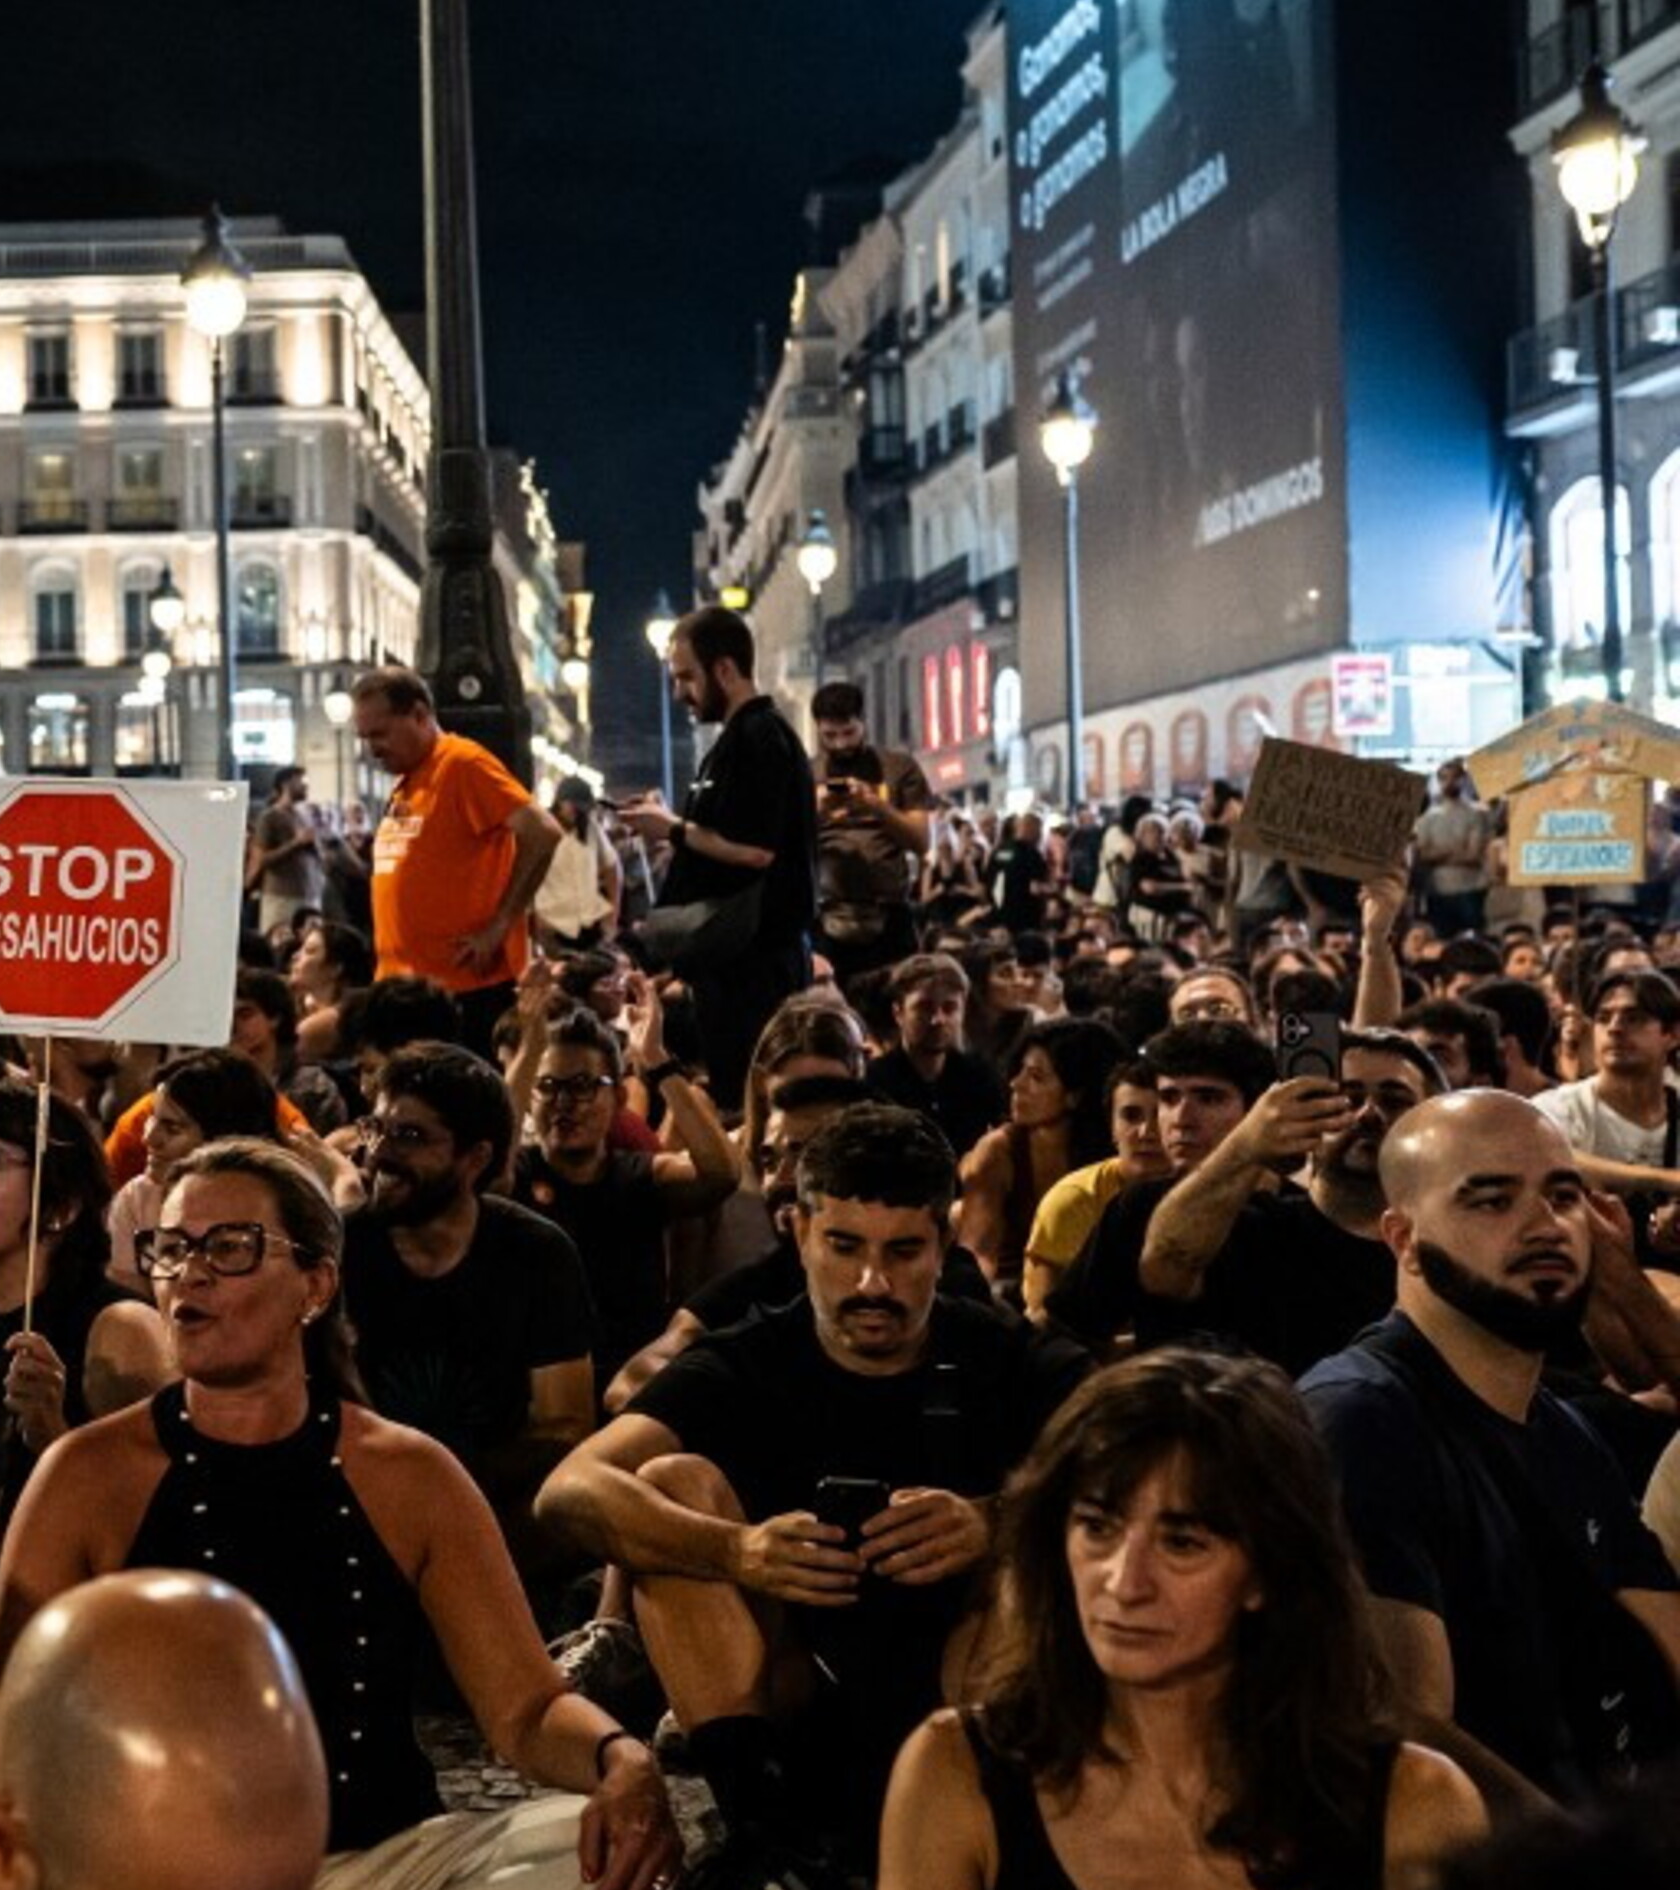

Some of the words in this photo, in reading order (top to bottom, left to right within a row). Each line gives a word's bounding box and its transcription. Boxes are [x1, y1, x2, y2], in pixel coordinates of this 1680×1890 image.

[1121, 220, 1139, 264] LA
[1139, 192, 1177, 250] BOLA
[1177, 152, 1228, 220] NEGRA
